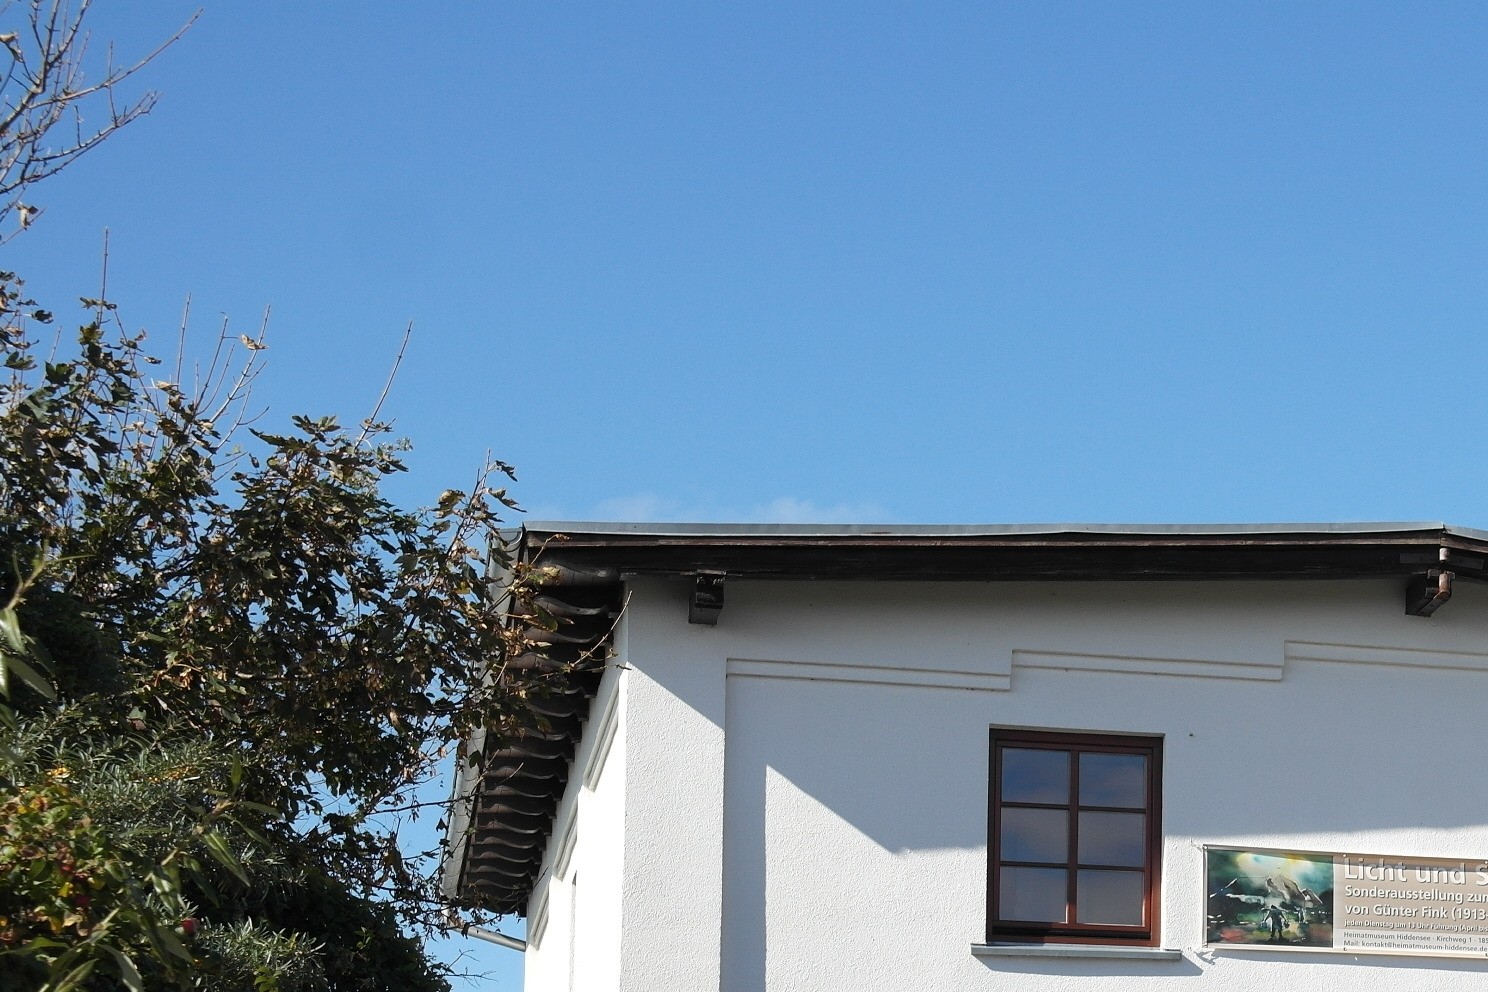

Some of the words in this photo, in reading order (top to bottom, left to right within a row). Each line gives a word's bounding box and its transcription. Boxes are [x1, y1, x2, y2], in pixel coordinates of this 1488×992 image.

[1344, 857, 1407, 882] Licht
[1415, 862, 1466, 885] und
[1344, 885, 1464, 905] Sonderausstellung
[1345, 904, 1369, 915] von
[1373, 904, 1418, 917] Günter
[1421, 905, 1448, 919] Fink
[1396, 921, 1406, 929] um
[1343, 931, 1395, 940] Heimatmuseum
[1396, 934, 1431, 942] Hiddensee
[1436, 935, 1467, 944] Kirchweg
[1361, 941, 1488, 952] kontakt@heimatmuseum-hiddensee.de
